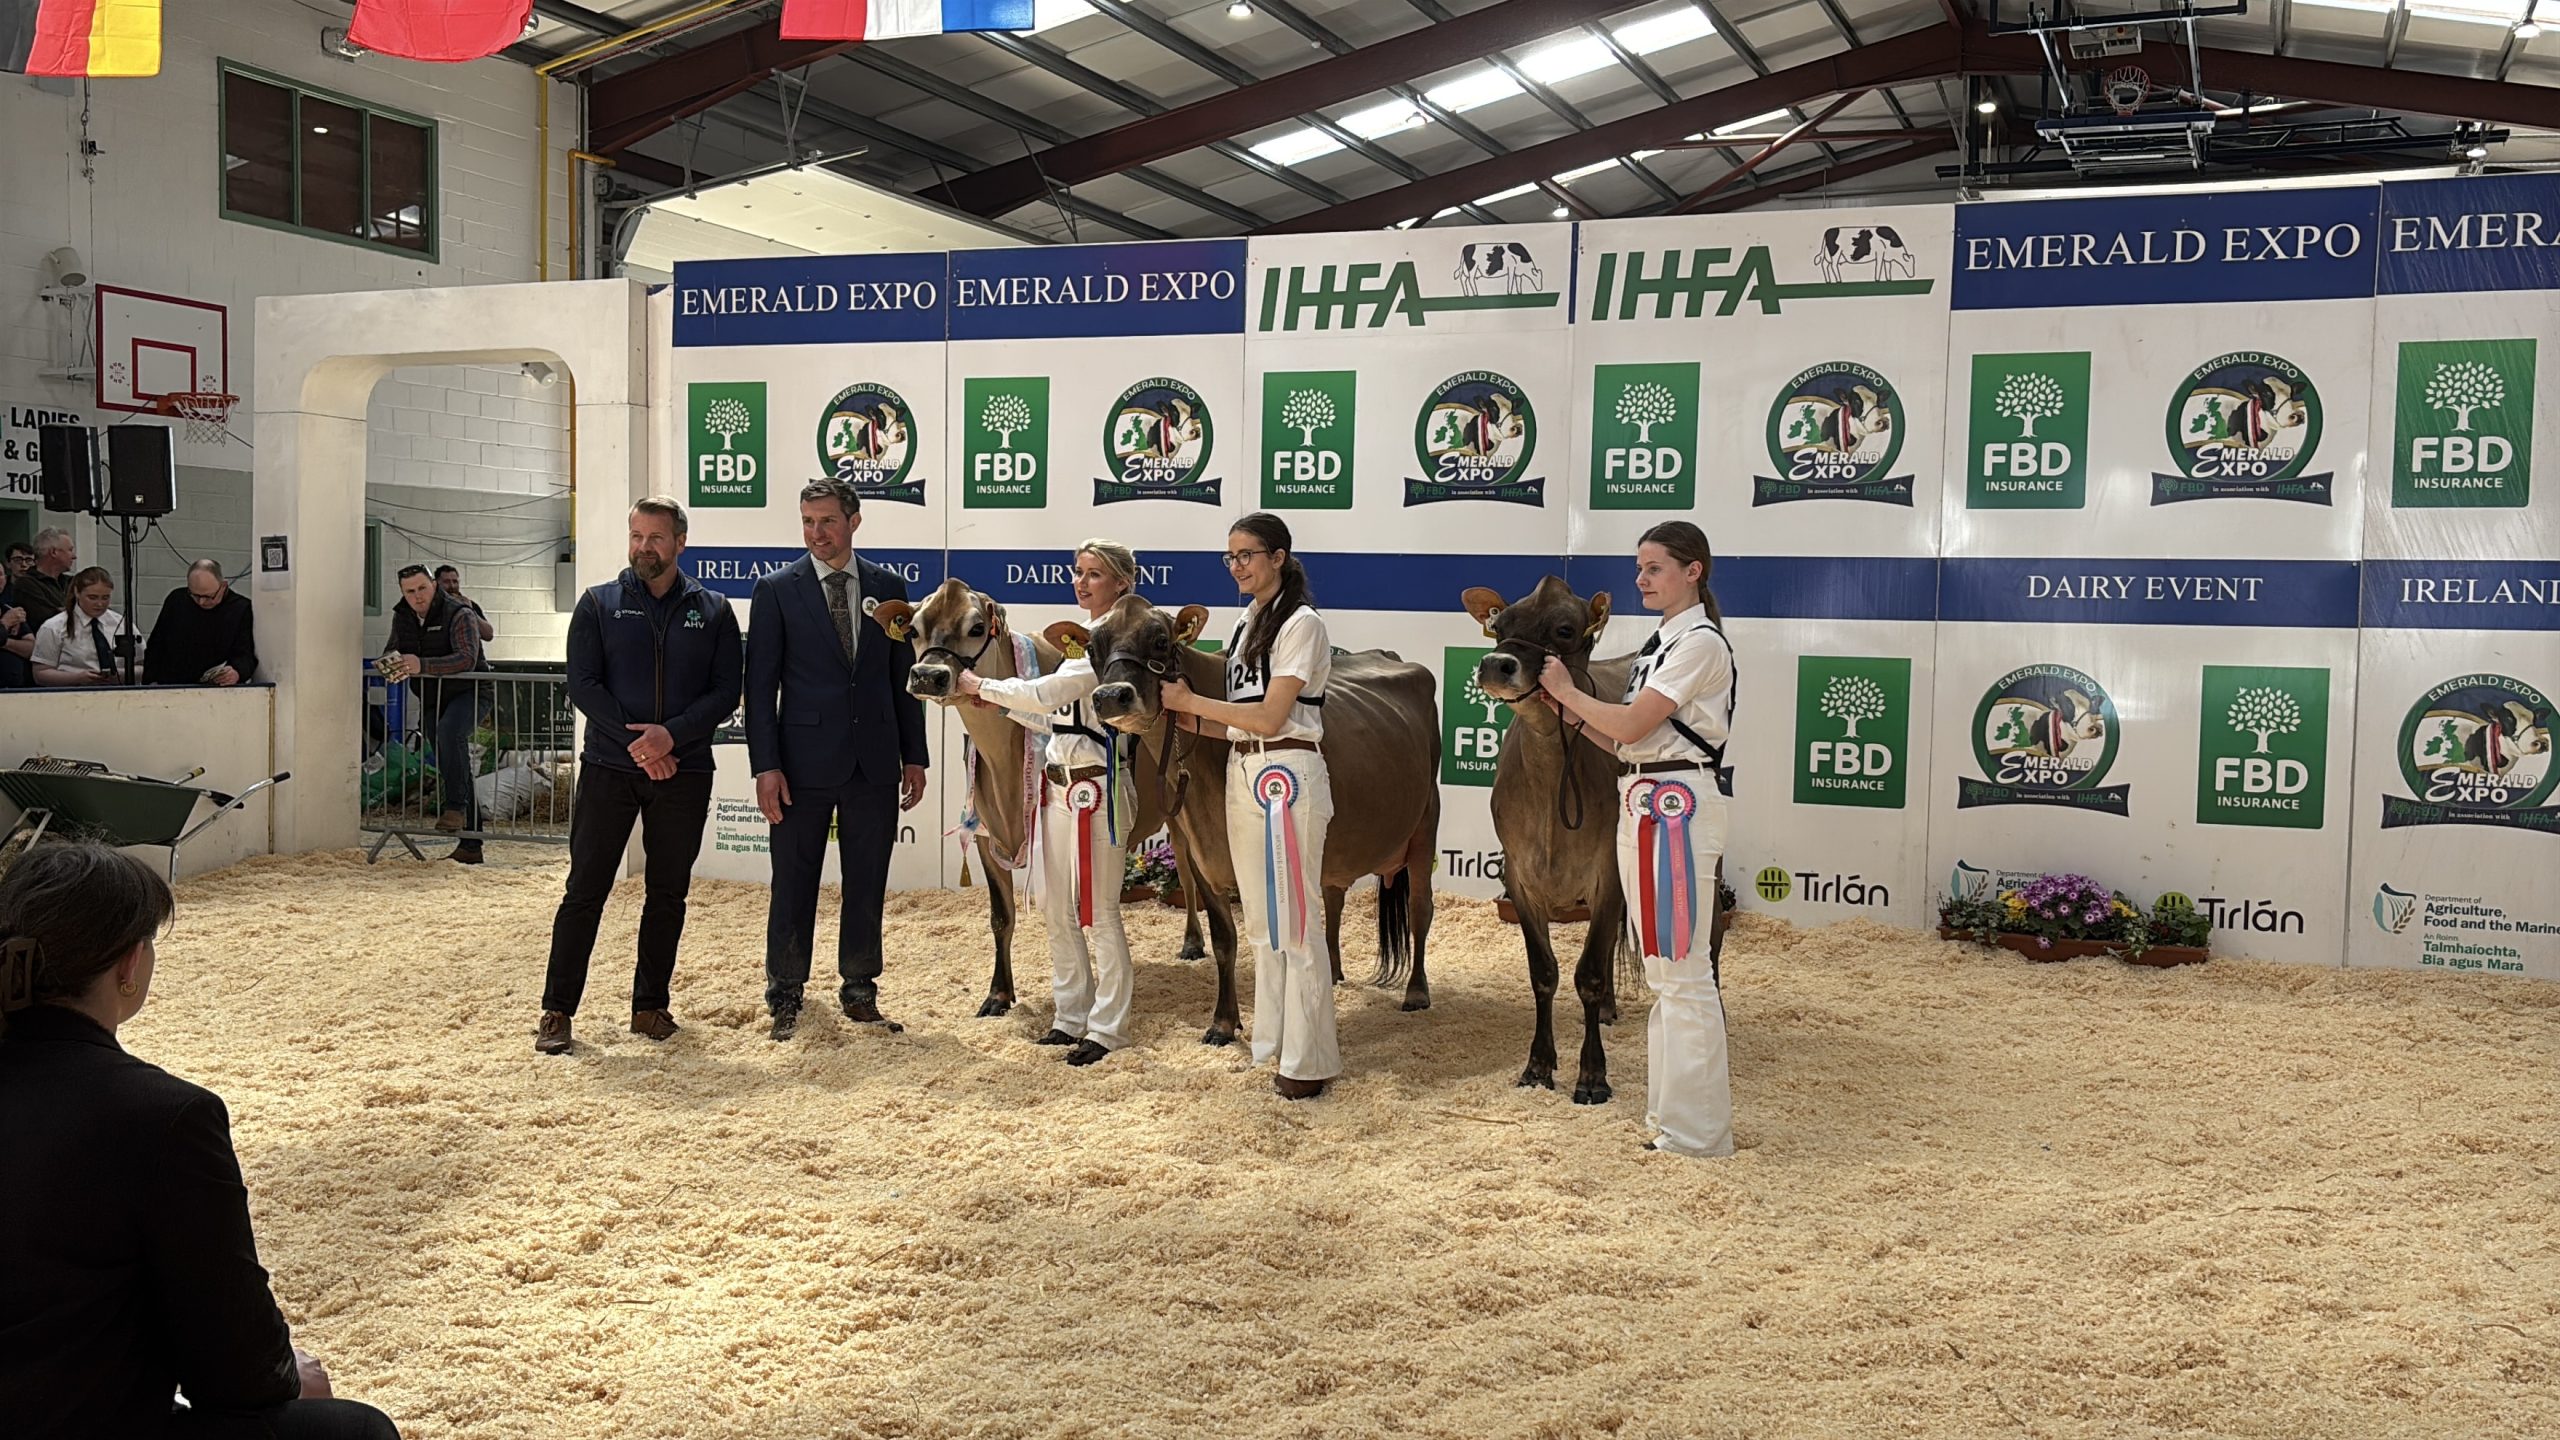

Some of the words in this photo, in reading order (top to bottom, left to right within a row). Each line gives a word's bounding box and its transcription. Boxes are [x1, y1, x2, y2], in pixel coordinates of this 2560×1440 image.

[1965, 228, 2206, 271] EMERALD
[2222, 222, 2361, 262] EXPO
[956, 274, 1129, 307] EMERALD
[1139, 270, 1236, 301] EXPO
[1591, 245, 1781, 320] IHFA
[681, 285, 838, 315] EMERALD
[848, 281, 936, 310] EXPO
[1258, 260, 1426, 332] IHFA
[1791, 363, 1849, 389] EMERALD
[1852, 365, 1884, 387] EXPO
[2193, 353, 2259, 380] EMERALD
[2262, 355, 2298, 379] EXPO
[833, 384, 875, 405] EMERALD
[877, 385, 901, 405] EXPO
[1122, 379, 1168, 402] EMERALD
[1170, 381, 1196, 400] EXPO
[1436, 372, 1487, 396] EMERALD
[1489, 374, 1517, 395] EXPO
[4, 440, 19, 461] &
[1983, 442, 2071, 476] FBD
[2412, 436, 2513, 473] FBD
[699, 454, 756, 482] FBD
[974, 452, 1036, 481] FBD
[1273, 450, 1342, 481] FBD
[1605, 447, 1682, 480] FBD
[7, 472, 45, 495] TOIL
[701, 485, 752, 494] INSURANCE
[976, 485, 1031, 494] INSURANCE
[1275, 484, 1336, 494] INSURANCE
[1607, 483, 1675, 493] INSURANCE
[1986, 481, 2063, 491] INSURANCE
[2414, 477, 2504, 489] INSURANCE
[696, 560, 792, 579] IRELAN
[1006, 564, 1075, 584] DAIRY
[2026, 575, 2136, 600] DAIRY
[2145, 577, 2263, 602] EVENT
[683, 620, 705, 629] AHV
[1227, 663, 1258, 693] 124
[1998, 666, 2059, 690] EMERALD
[2063, 668, 2096, 692] EXPO
[2428, 676, 2499, 702] EMERALD
[2502, 679, 2541, 704] EXPO
[1456, 760, 1497, 771] INSURA
[1809, 741, 1893, 776] FBD
[1811, 778, 1885, 791] INSURANCE
[2215, 757, 2309, 794] FBD
[716, 803, 761, 813] Agriculture
[2217, 796, 2300, 810] INSURANCE
[716, 813, 736, 822] Food
[737, 814, 752, 823] and
[753, 815, 767, 823] the
[716, 842, 729, 850] Bia
[731, 844, 751, 853] agus
[752, 844, 770, 853] Mar
[1442, 849, 1505, 880] Tirlá
[1996, 869, 2037, 878] Department
[2425, 894, 2472, 904] Department
[2425, 902, 2507, 919] Agriculture,
[2423, 916, 2457, 928] Food
[2460, 919, 2486, 930] and
[2489, 919, 2512, 931] the
[2422, 954, 2445, 966] Bia
[2449, 957, 2482, 970] agus
[2487, 959, 2524, 971] Mara
